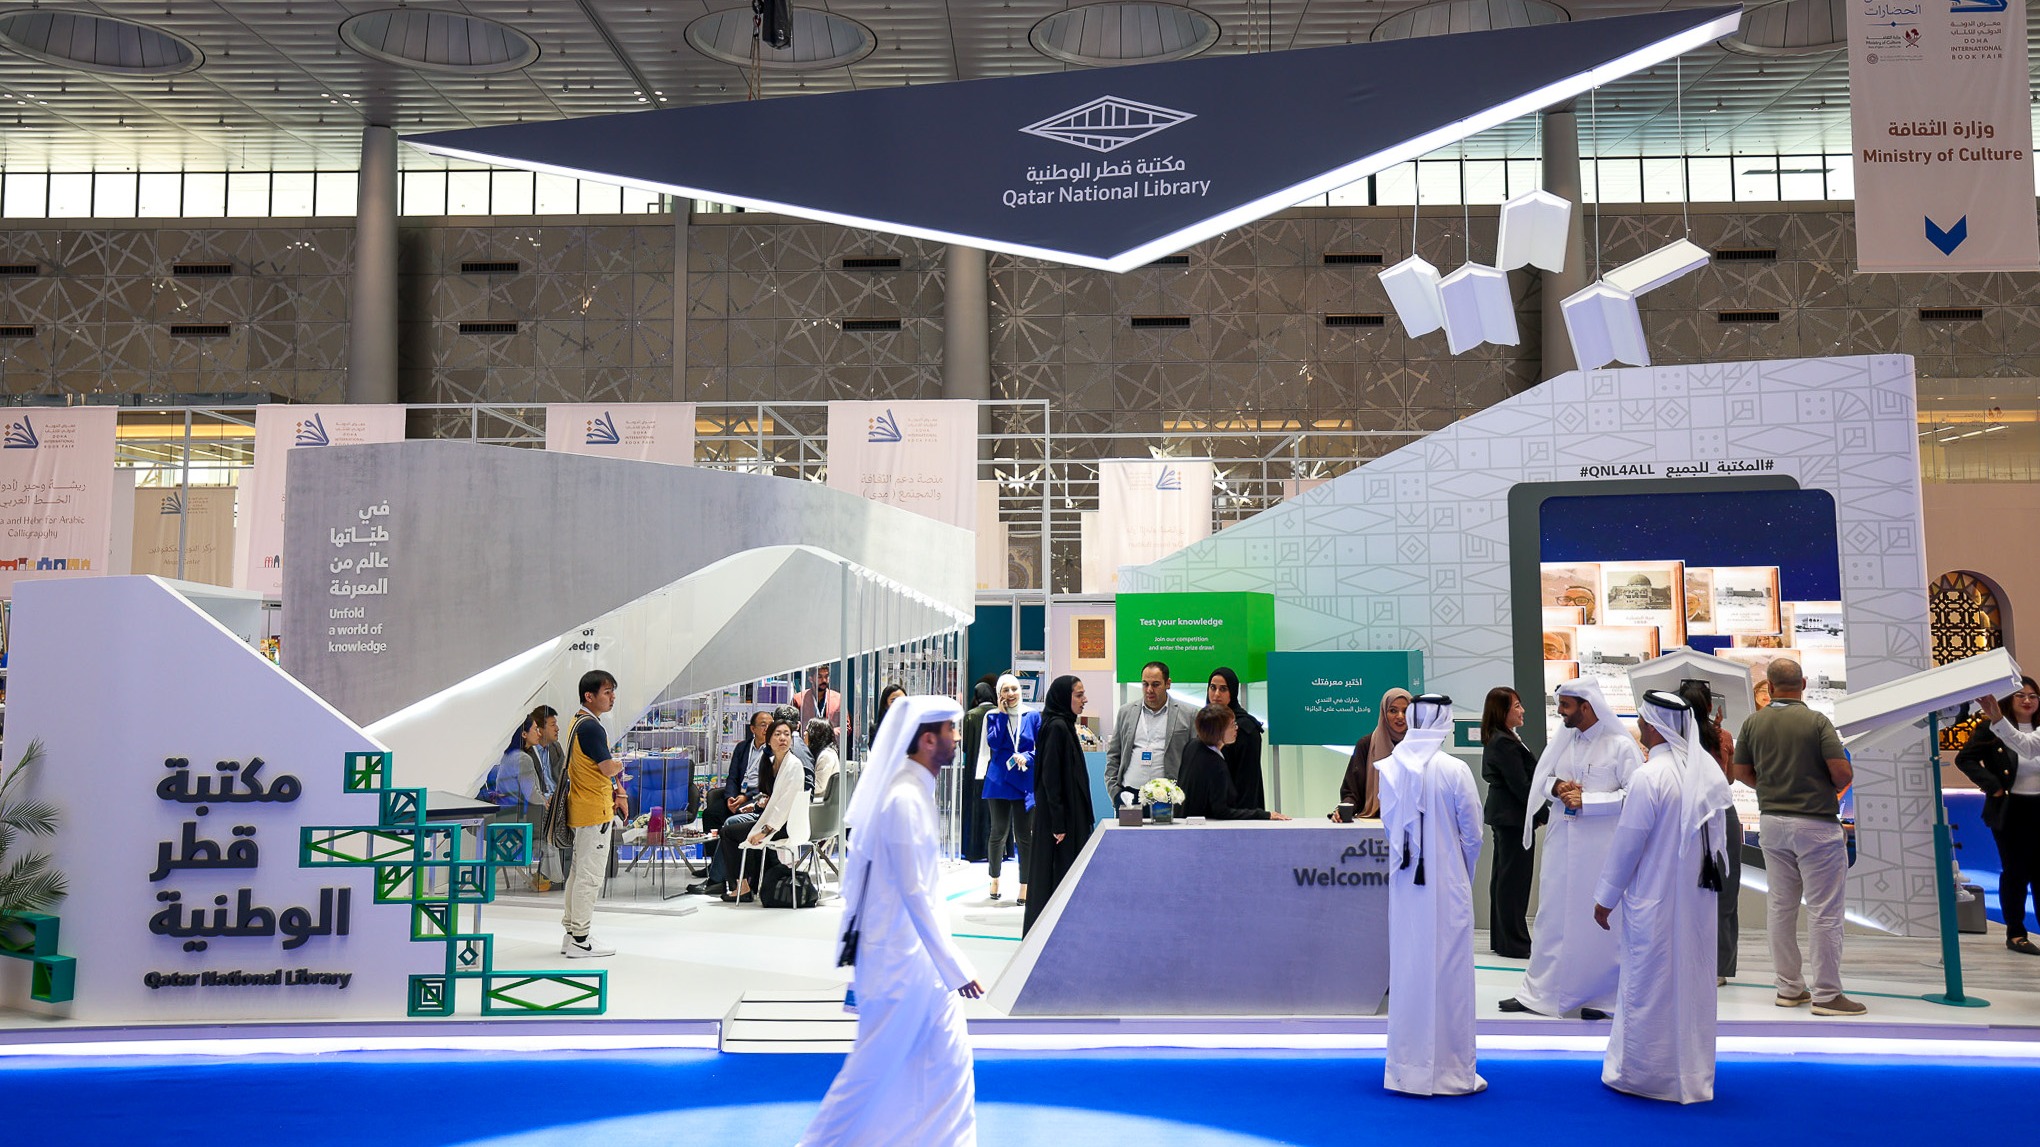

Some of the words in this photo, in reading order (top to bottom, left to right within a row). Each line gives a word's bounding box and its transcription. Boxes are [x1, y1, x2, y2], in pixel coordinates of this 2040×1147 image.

[1864, 4, 1921, 18] الحضارات
[1888, 119, 1947, 137] الثقافة
[1953, 120, 1995, 139] وزارة
[1863, 149, 1932, 165] Ministry
[1937, 149, 1954, 162] of
[1959, 147, 2023, 161] Culture
[1026, 162, 1091, 185] الوطنية
[1093, 160, 1133, 182] قطر
[1136, 155, 1186, 177] مكتبة
[1002, 189, 1054, 208] Qatar
[1058, 181, 1138, 203] National
[1144, 179, 1211, 197] Library
[1580, 464, 1655, 478] #QNL4ALL
[6, 516, 21, 525] and
[59, 515, 85, 525] Arabic
[358, 500, 390, 524] في
[329, 557, 353, 574] من
[356, 551, 389, 575] عالم
[329, 577, 388, 600] المعرفة
[329, 607, 365, 619] Unfold
[328, 626, 336, 636] a
[336, 624, 369, 636] world
[370, 623, 383, 636] of
[1139, 618, 1156, 626] Test
[1157, 619, 1177, 628] your
[1177, 617, 1224, 627] knowledge
[328, 640, 387, 654] knowledge
[1311, 677, 1343, 687] معرفتك
[1344, 678, 1363, 688] اختبر
[156, 756, 303, 817] مكتبة
[149, 820, 259, 882] قطر
[149, 887, 352, 952] الوطنية
[144, 971, 200, 989] Qatar
[201, 969, 283, 987] National
[285, 968, 353, 990] Library
